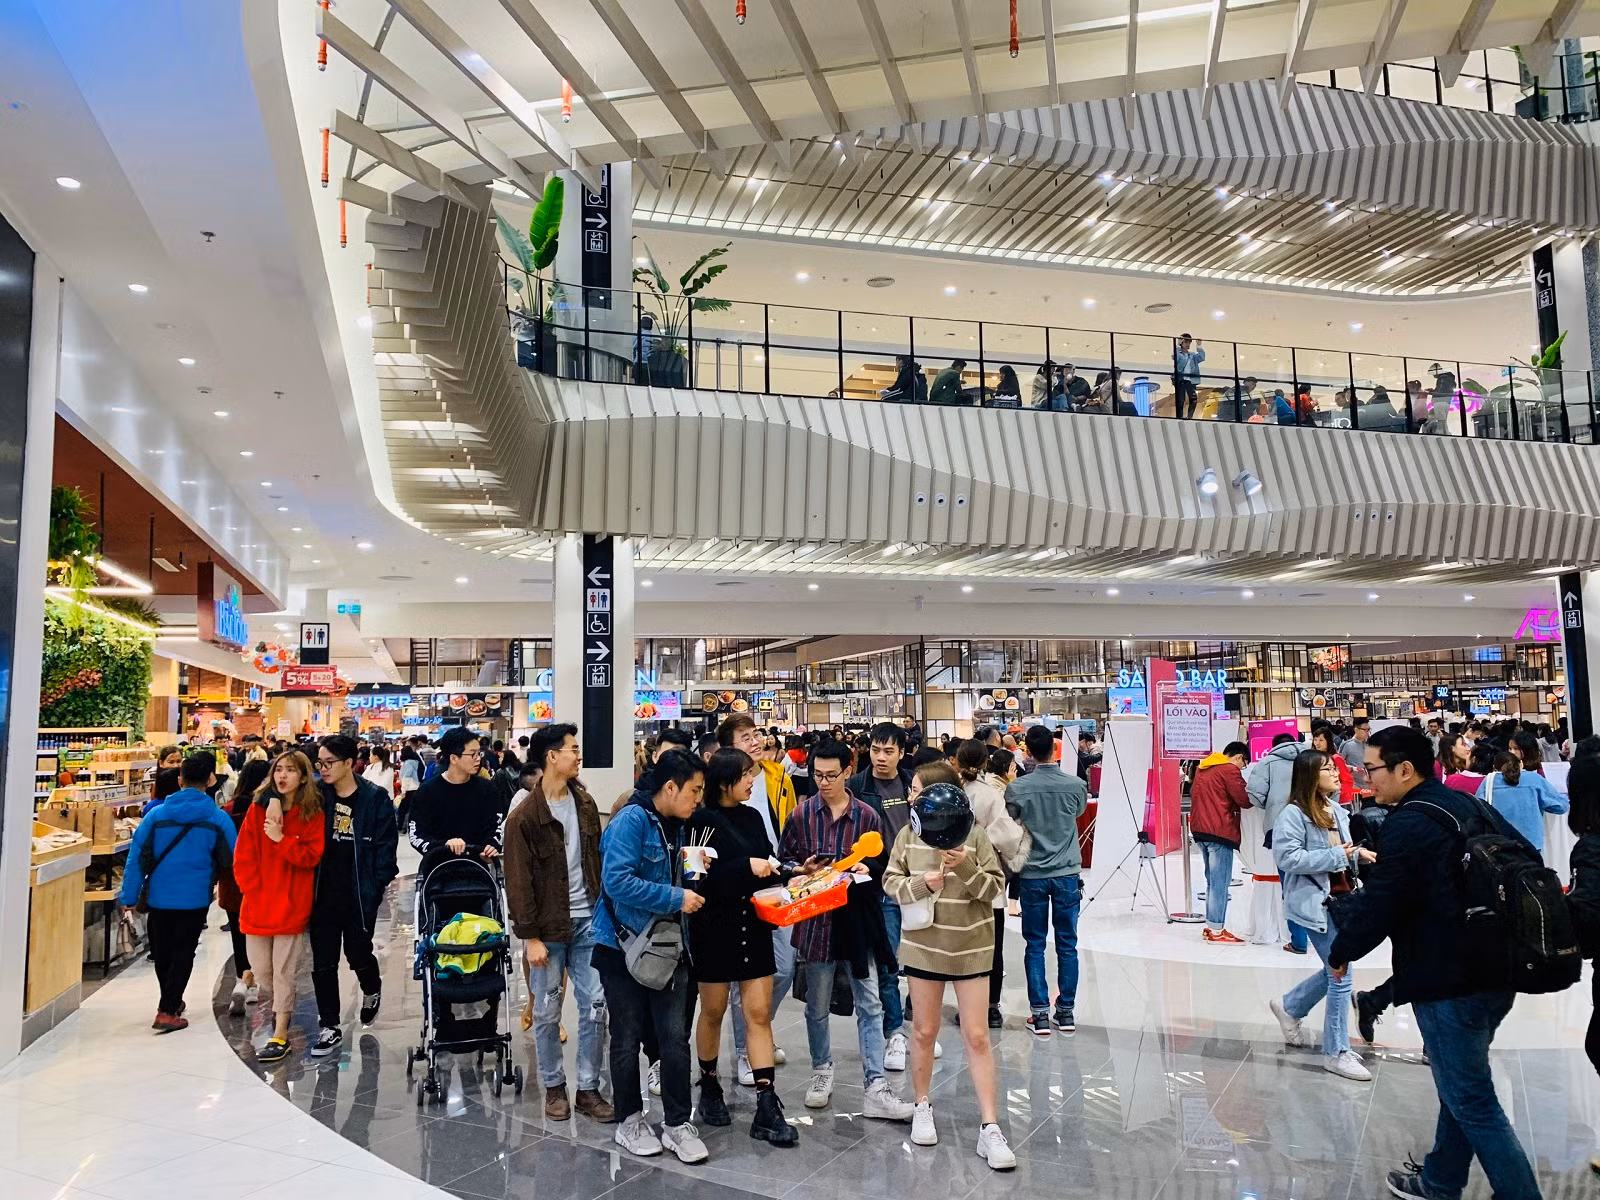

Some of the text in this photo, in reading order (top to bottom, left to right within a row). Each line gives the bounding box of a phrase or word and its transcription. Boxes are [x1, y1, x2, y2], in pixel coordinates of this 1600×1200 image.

[1191, 668, 1228, 688] BAR
[1437, 687, 1448, 697] 502
[1166, 706, 1207, 717] LỐI VÀO
